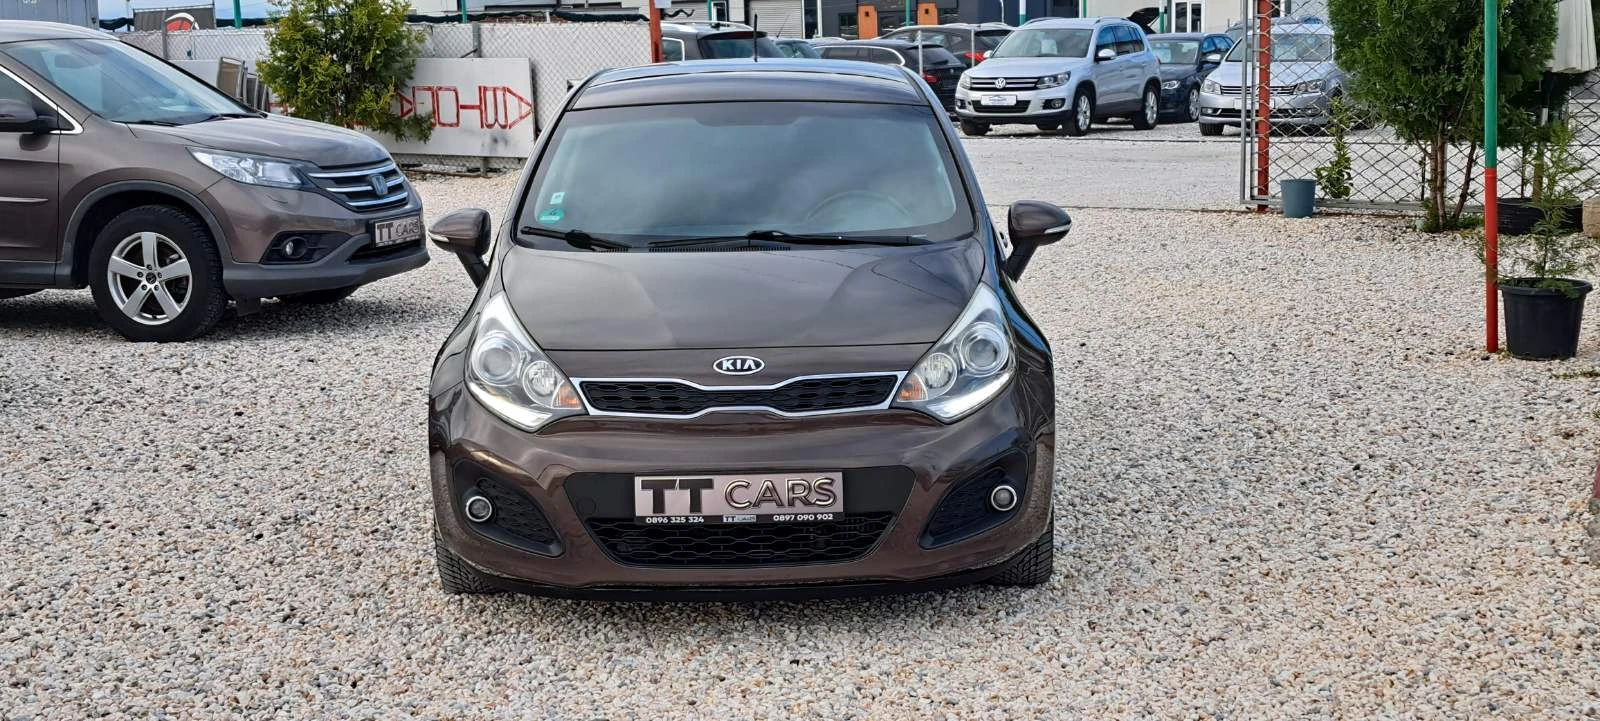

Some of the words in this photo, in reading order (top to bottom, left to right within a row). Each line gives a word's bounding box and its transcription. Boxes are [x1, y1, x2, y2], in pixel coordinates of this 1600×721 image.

[376, 222, 394, 241] TT
[395, 218, 419, 236] CARS
[721, 359, 756, 371] KIA
[640, 478, 714, 514] TT
[724, 476, 837, 510] CARS
[645, 516, 669, 524] 0896
[670, 516, 687, 524] 325
[688, 515, 705, 523] 324
[773, 514, 796, 522] 0897
[797, 513, 815, 521] 090
